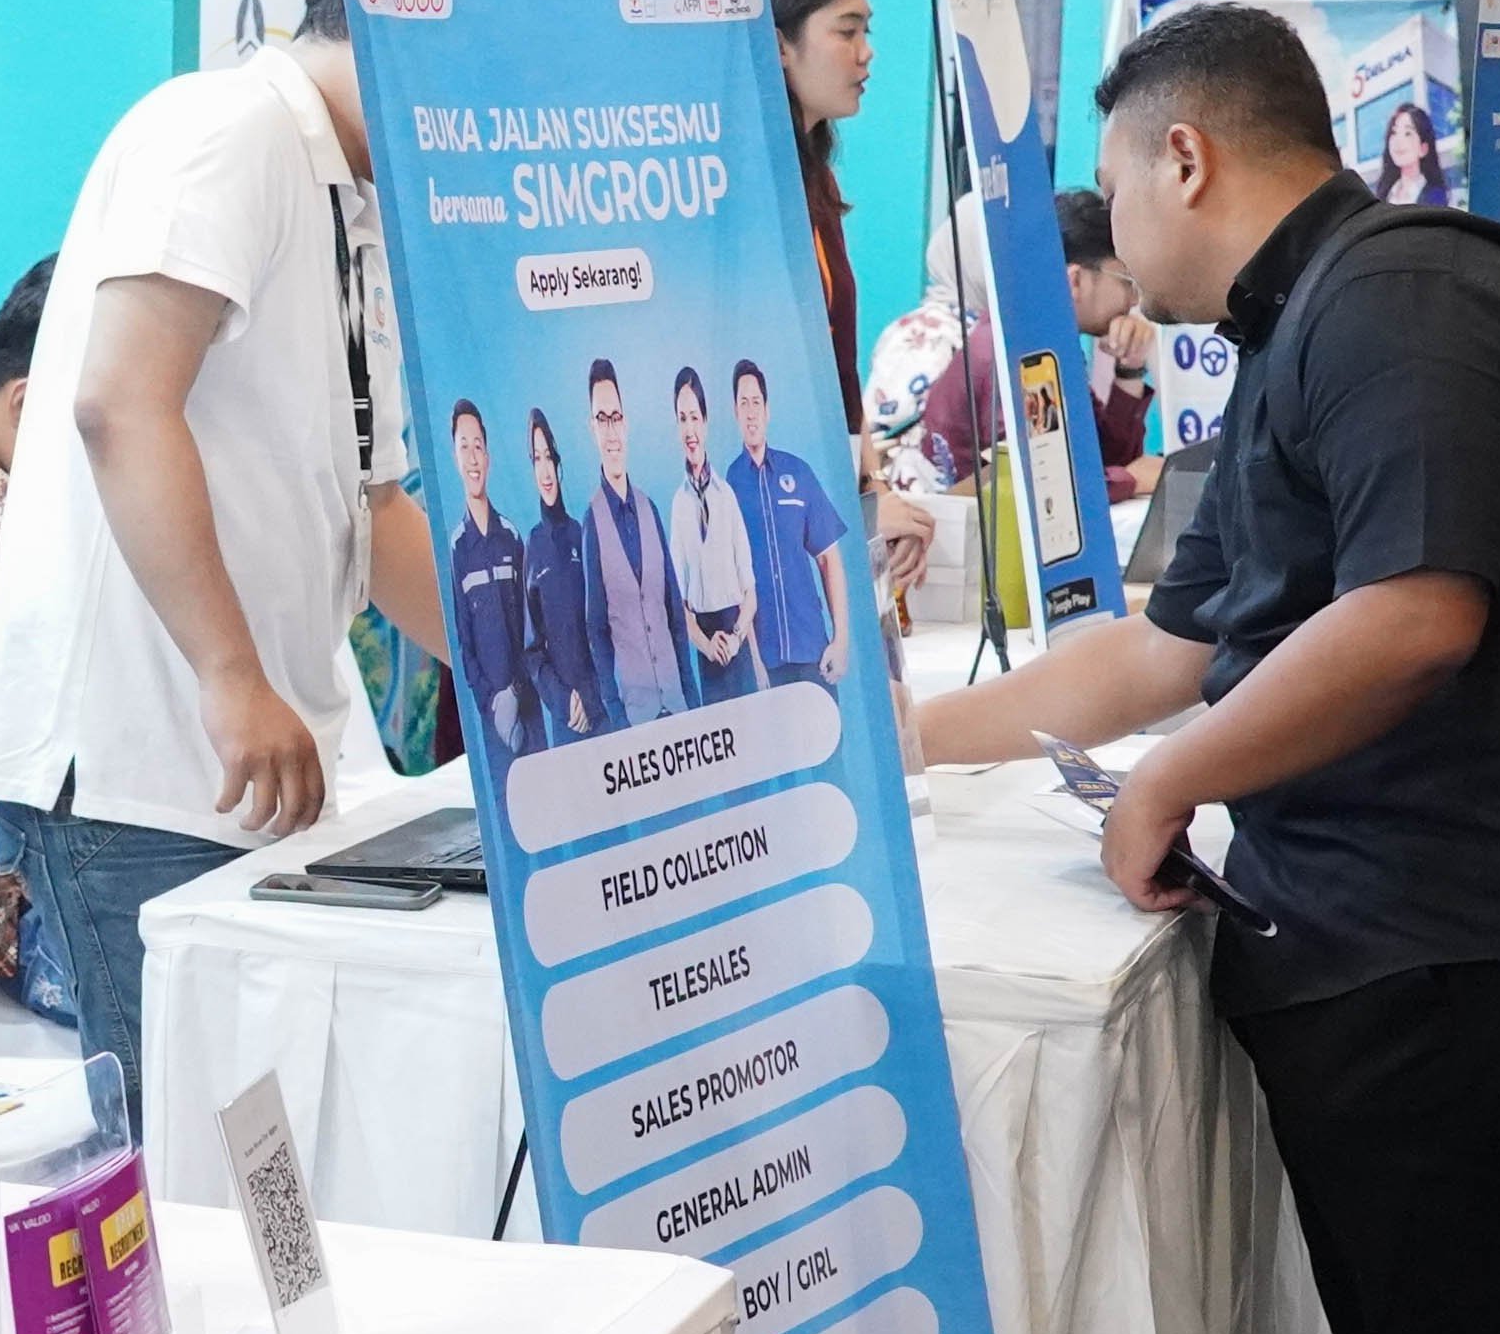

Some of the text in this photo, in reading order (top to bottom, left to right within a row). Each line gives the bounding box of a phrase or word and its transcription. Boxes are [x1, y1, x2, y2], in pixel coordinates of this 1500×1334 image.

[413, 102, 721, 152] BUKA JALAN SUKSESMU
[429, 154, 728, 229] bersama SIMGROUP
[529, 261, 642, 296] Apply Sekarang!
[603, 728, 737, 795] SALES OFFICER
[601, 826, 769, 911] FIELD COLLECTION
[648, 945, 751, 1011] TELESALES
[631, 1039, 799, 1139] SALES PROMOTOR
[655, 1144, 812, 1244] GENERAL ADMIN
[742, 1271, 780, 1320] BOY
[796, 1246, 838, 1291] GIRL
